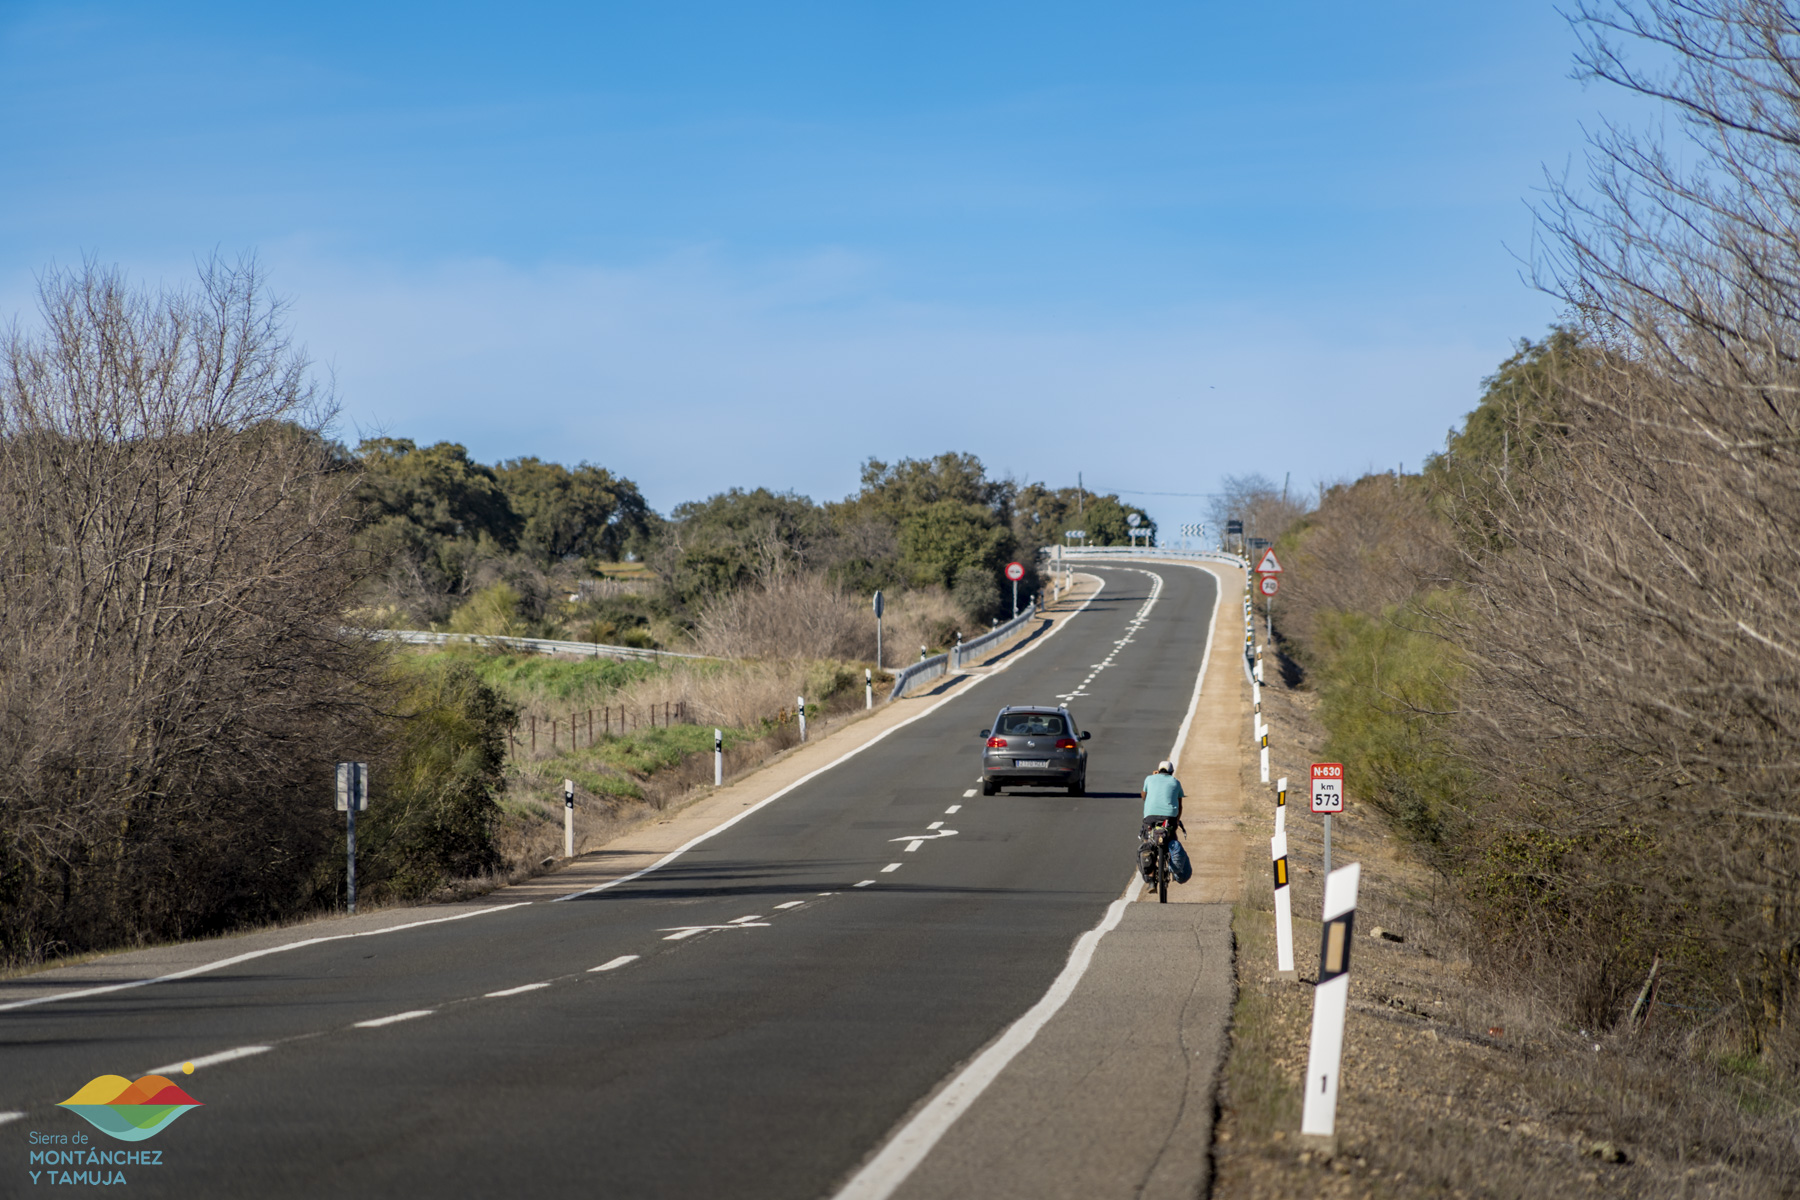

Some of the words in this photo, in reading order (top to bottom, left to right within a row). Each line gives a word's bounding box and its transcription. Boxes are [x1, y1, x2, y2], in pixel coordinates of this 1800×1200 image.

[1313, 766, 1341, 776] N-630
[1315, 793, 1340, 806] 573
[1320, 1074, 1328, 1094] 1
